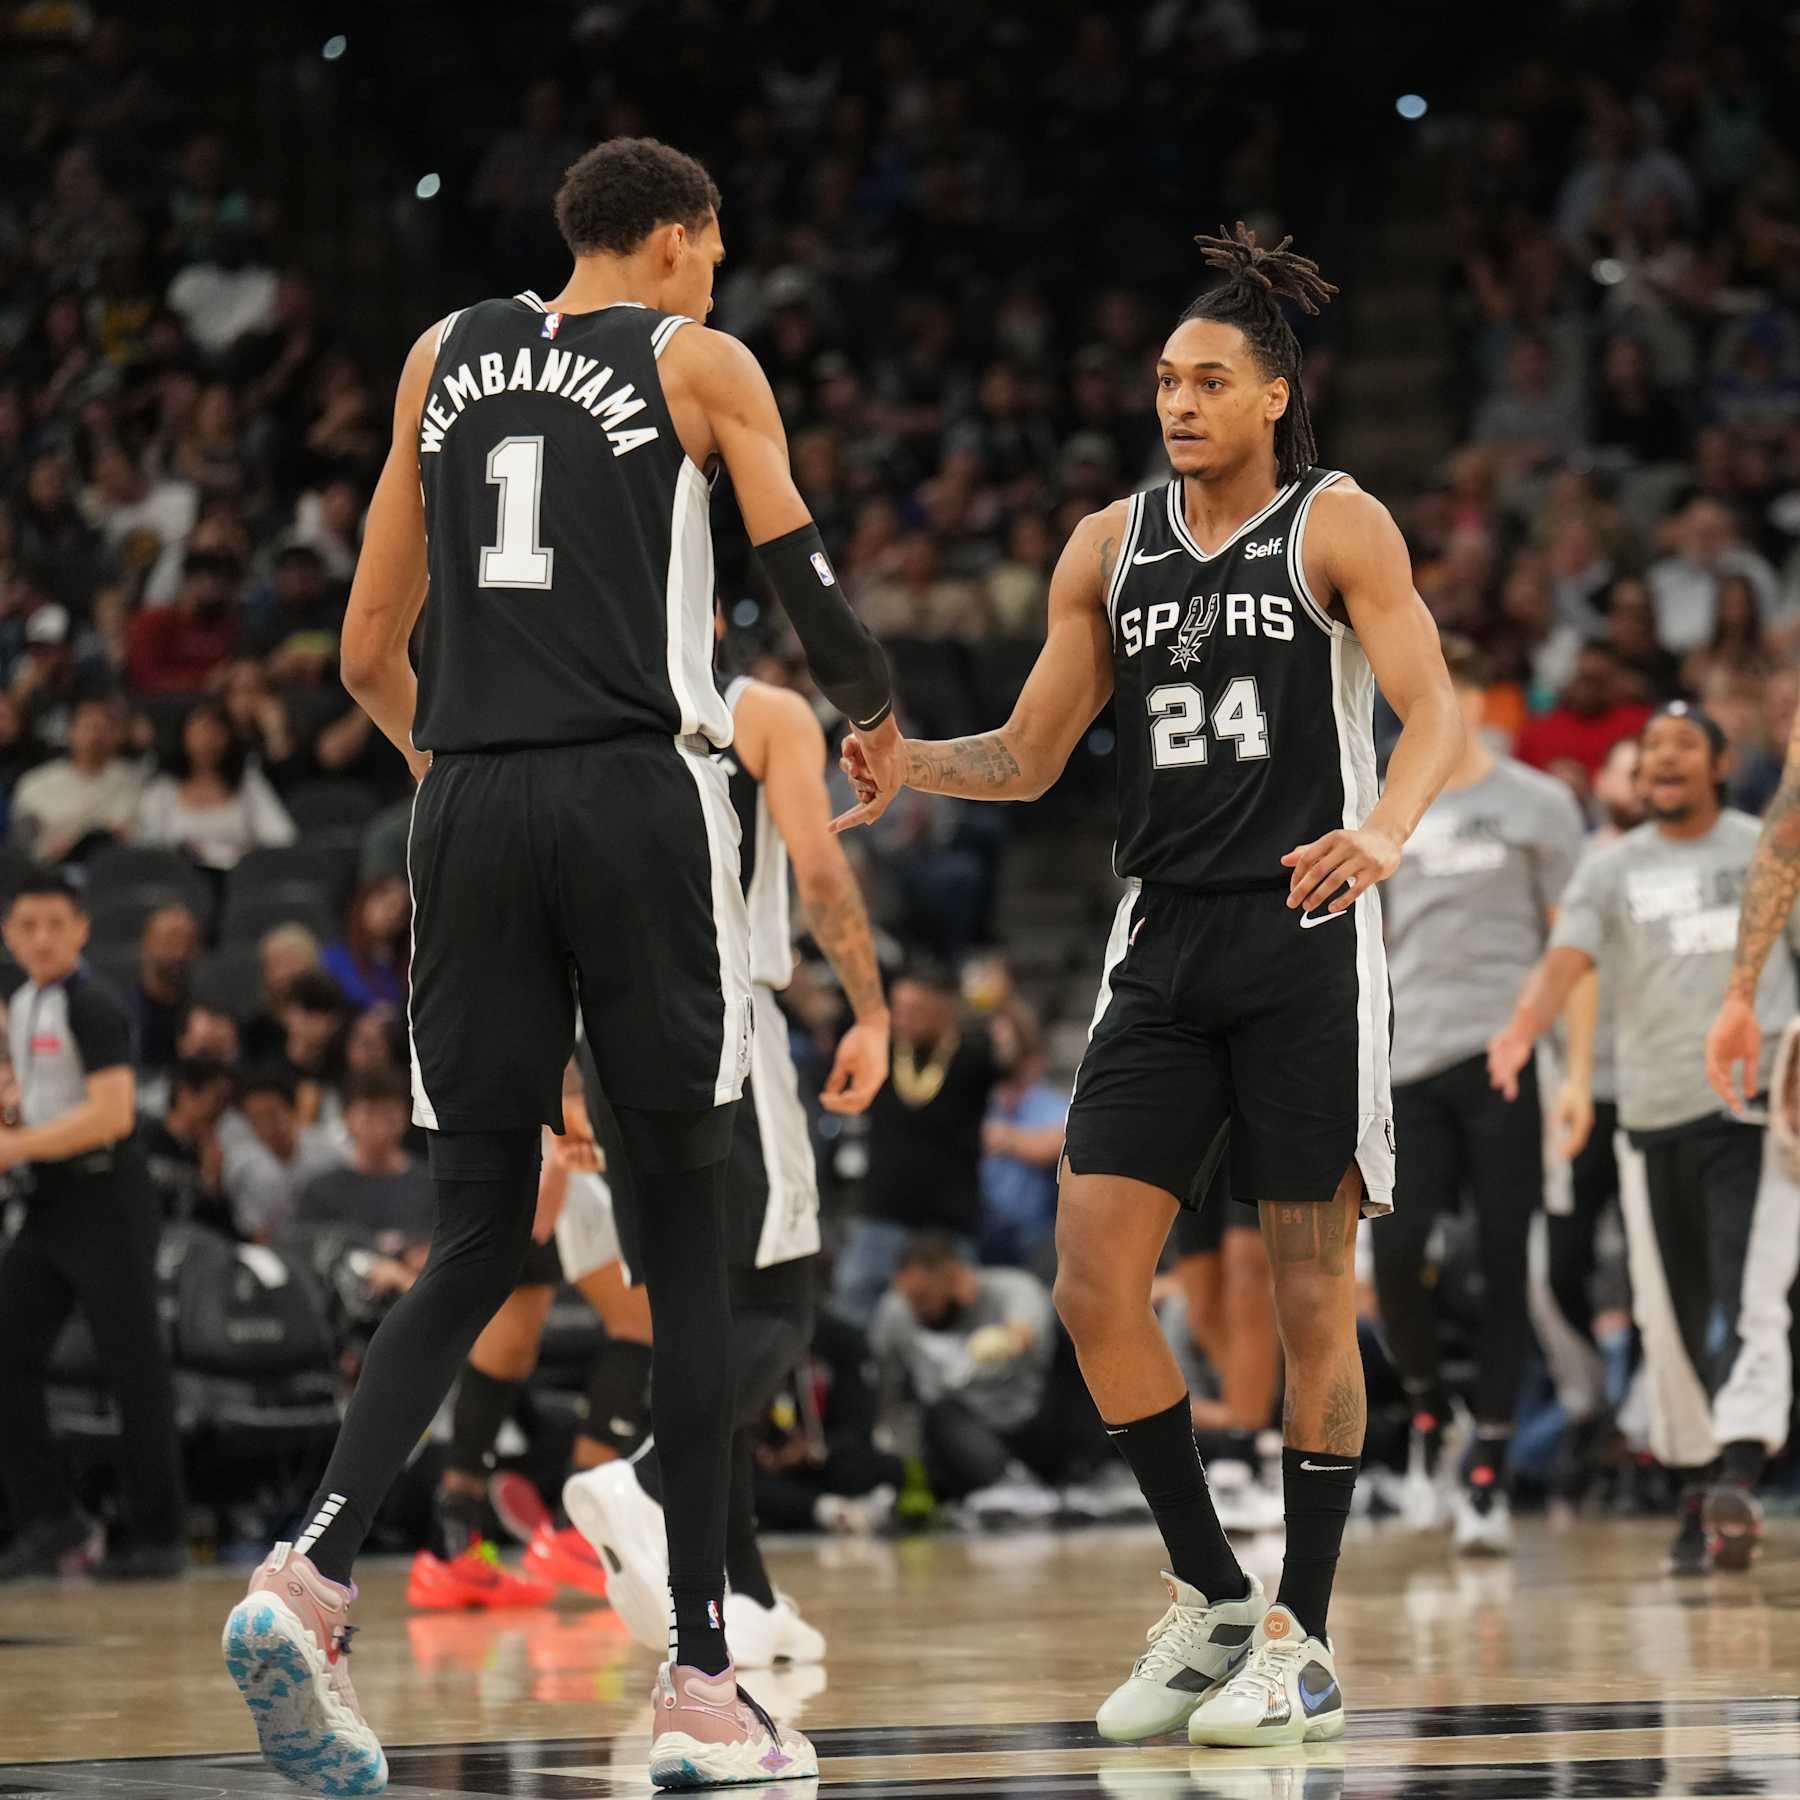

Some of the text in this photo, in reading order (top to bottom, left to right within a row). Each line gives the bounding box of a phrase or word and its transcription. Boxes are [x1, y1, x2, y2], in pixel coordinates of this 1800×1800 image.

[421, 347, 660, 457] WEMBANYAMA
[478, 435, 554, 590] 1
[1244, 537, 1284, 560] Self.
[1120, 592, 1295, 673] SPURS
[1146, 676, 1271, 770] 24
